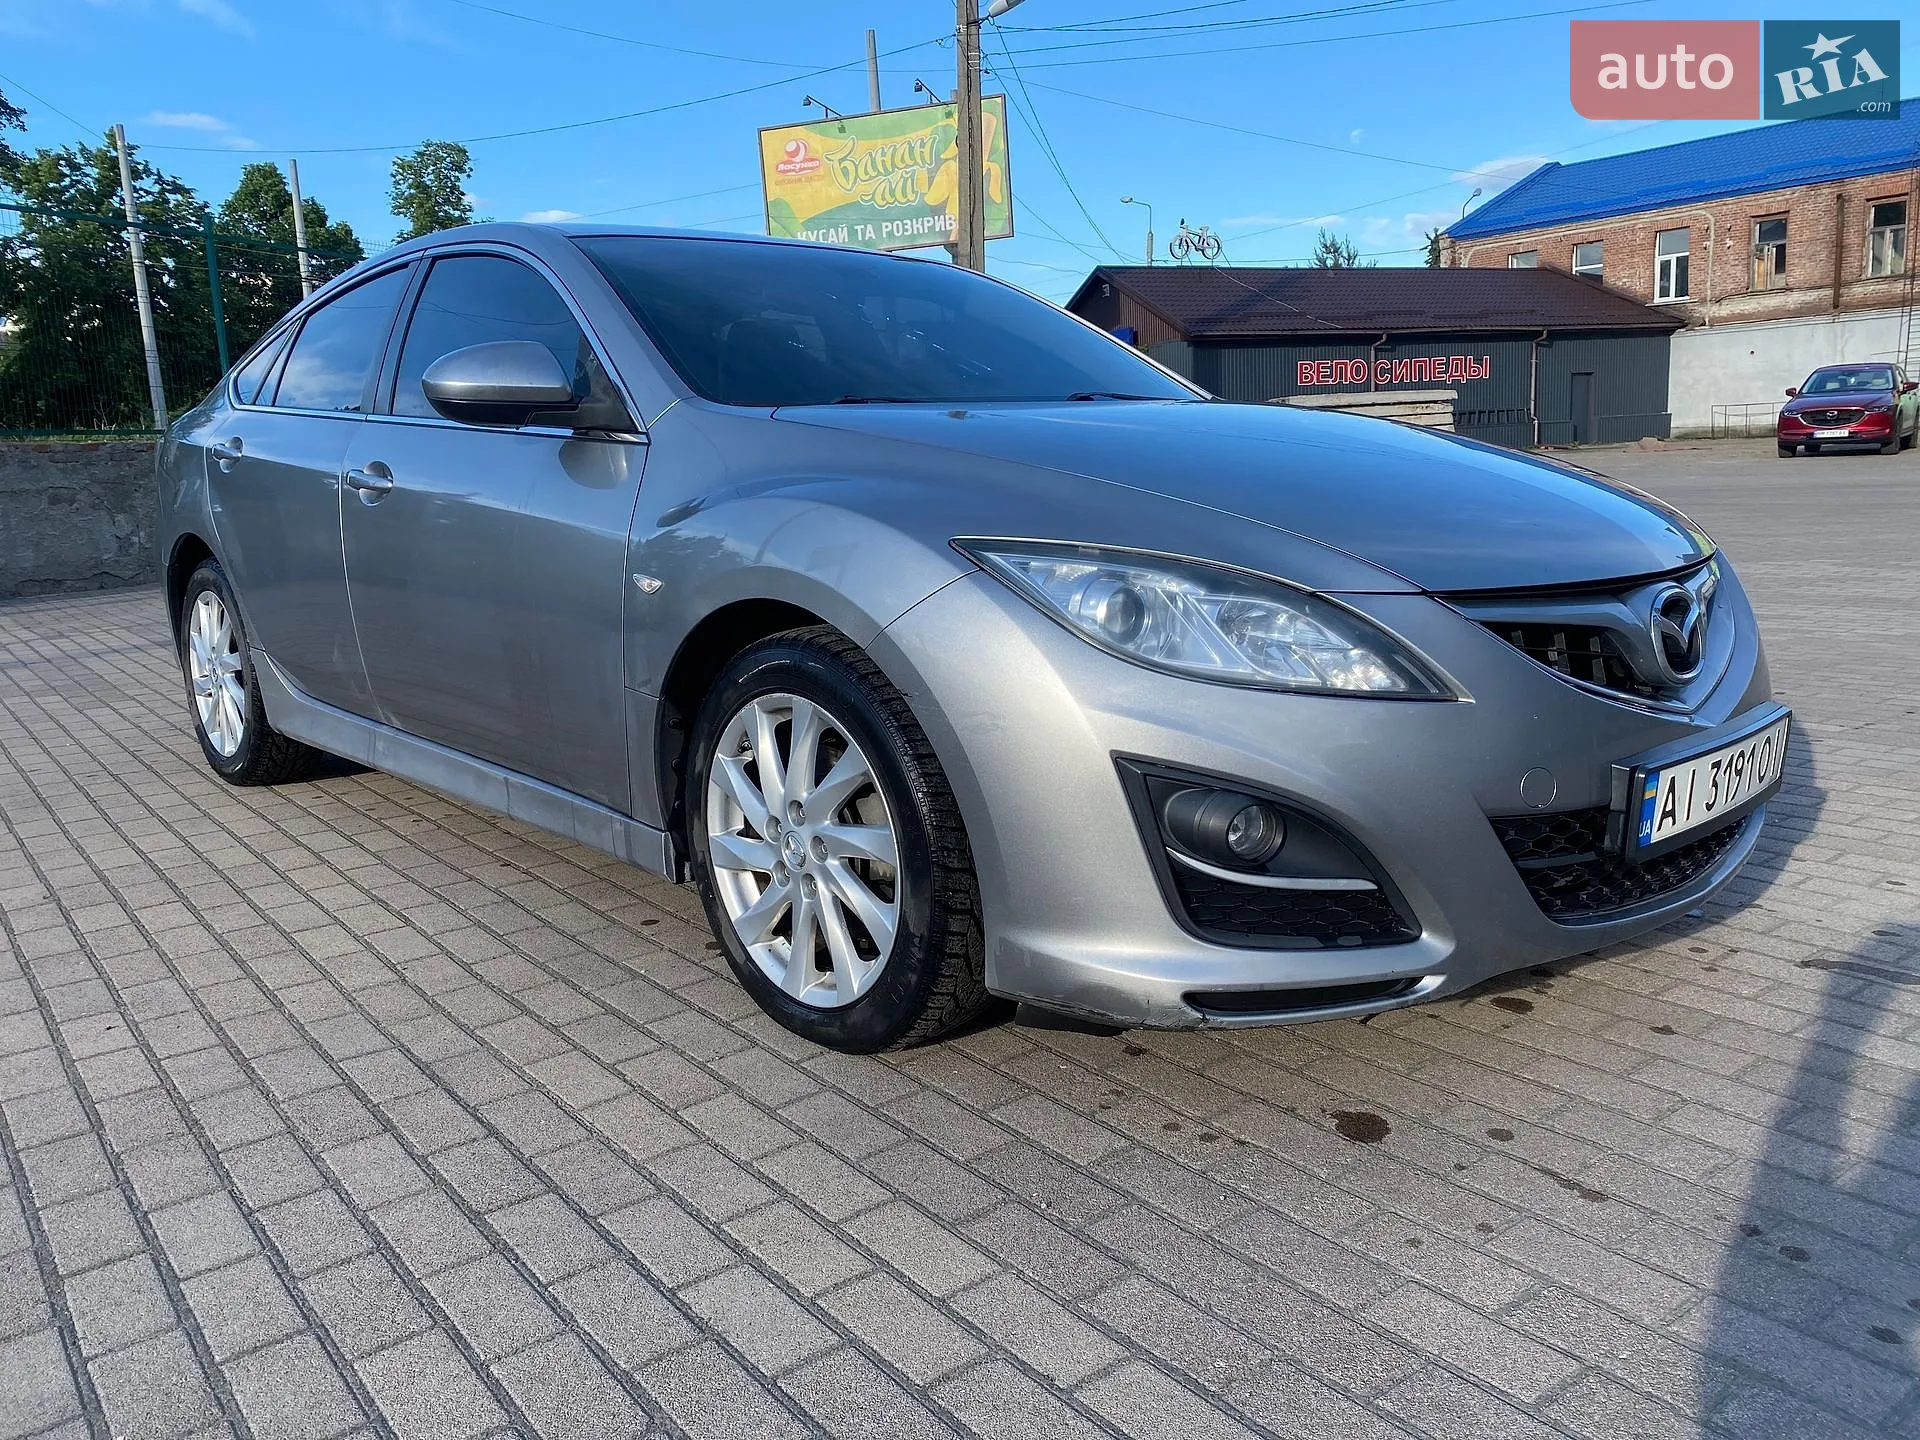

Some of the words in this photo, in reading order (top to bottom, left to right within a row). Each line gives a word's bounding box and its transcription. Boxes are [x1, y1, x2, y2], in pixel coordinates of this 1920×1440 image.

[854, 224, 875, 241] ТА
[882, 214, 955, 239] РОЗКРИВ
[1656, 768, 1696, 832] AI
[1704, 742, 1756, 812] 3191
[1638, 820, 1651, 837] UA
